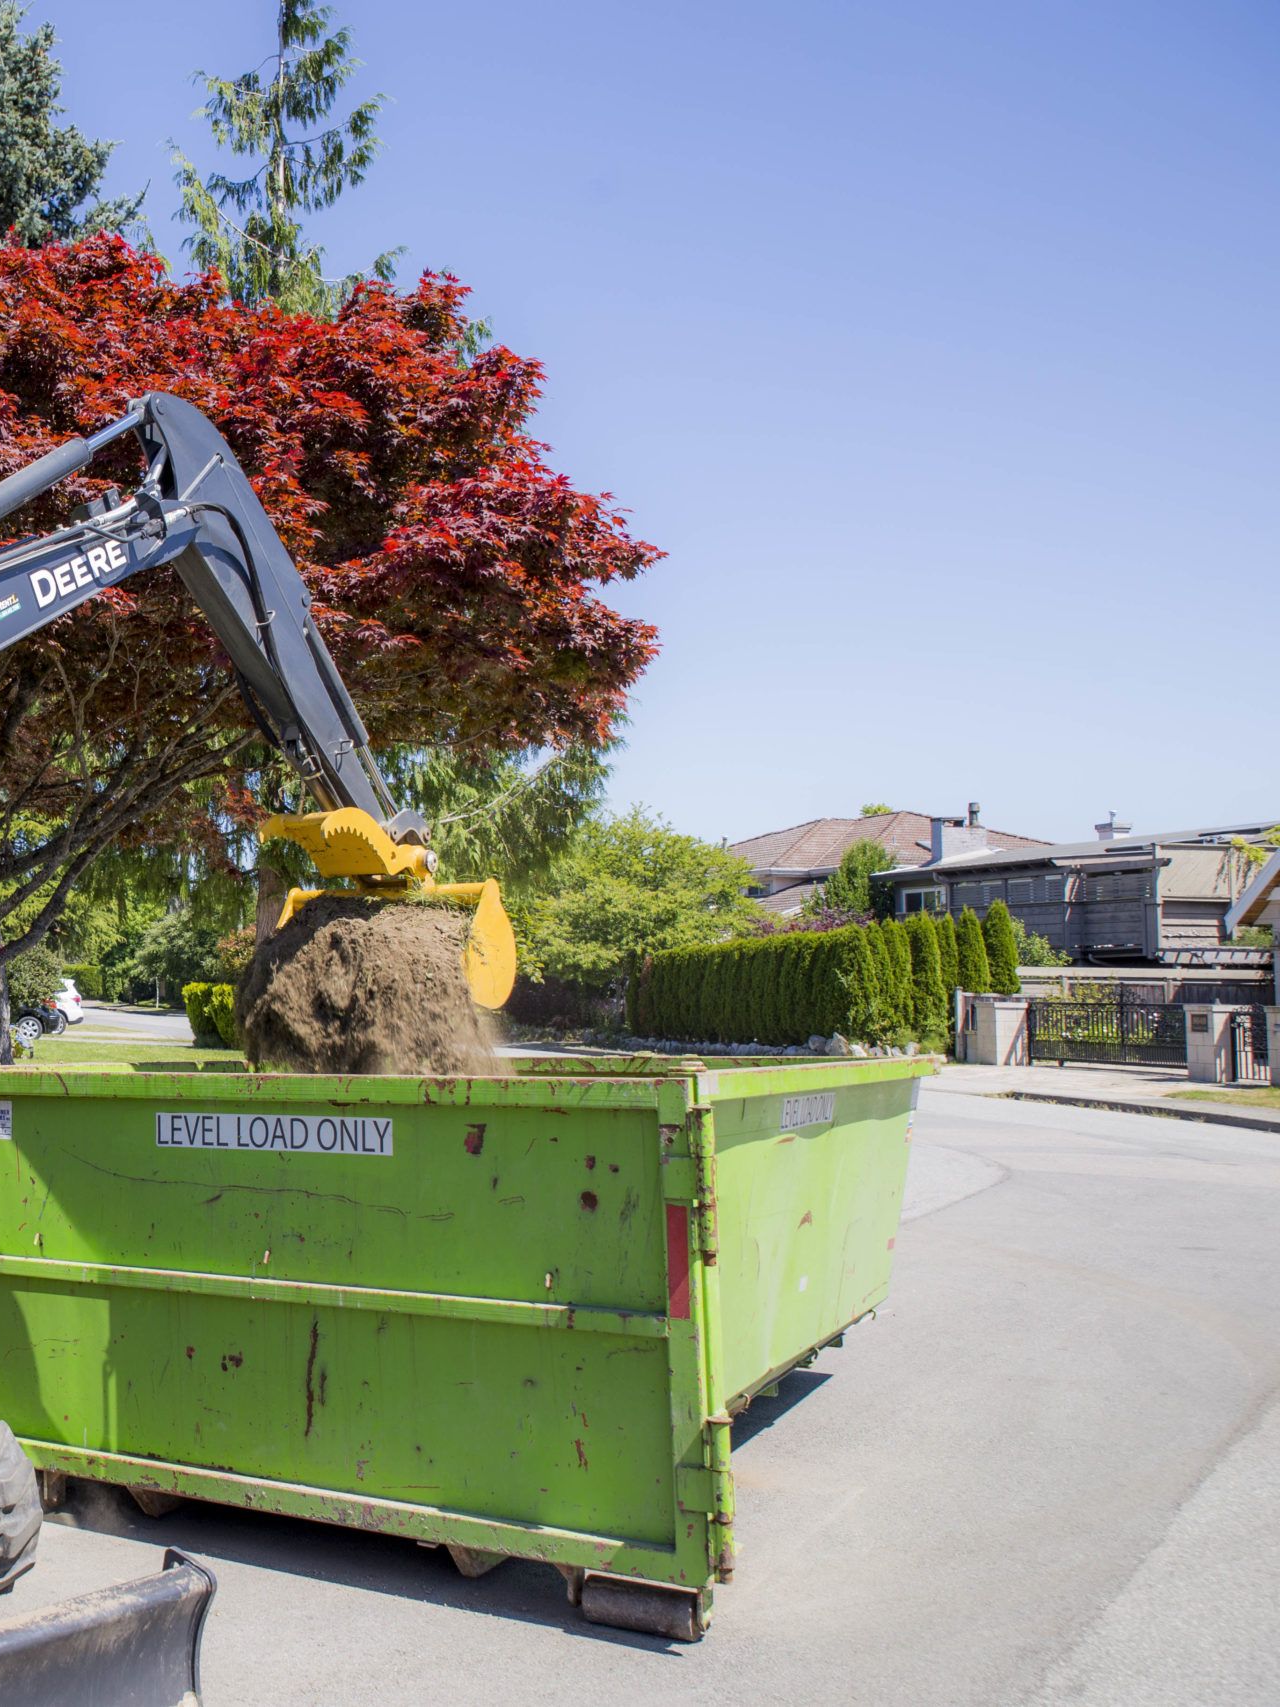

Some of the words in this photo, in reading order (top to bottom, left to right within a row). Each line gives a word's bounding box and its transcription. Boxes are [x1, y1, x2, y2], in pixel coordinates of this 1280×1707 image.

[29, 539, 128, 609] DEERE
[157, 1114, 228, 1147] LEVEL
[237, 1116, 309, 1150] LOAD
[316, 1118, 391, 1153] ONLY
